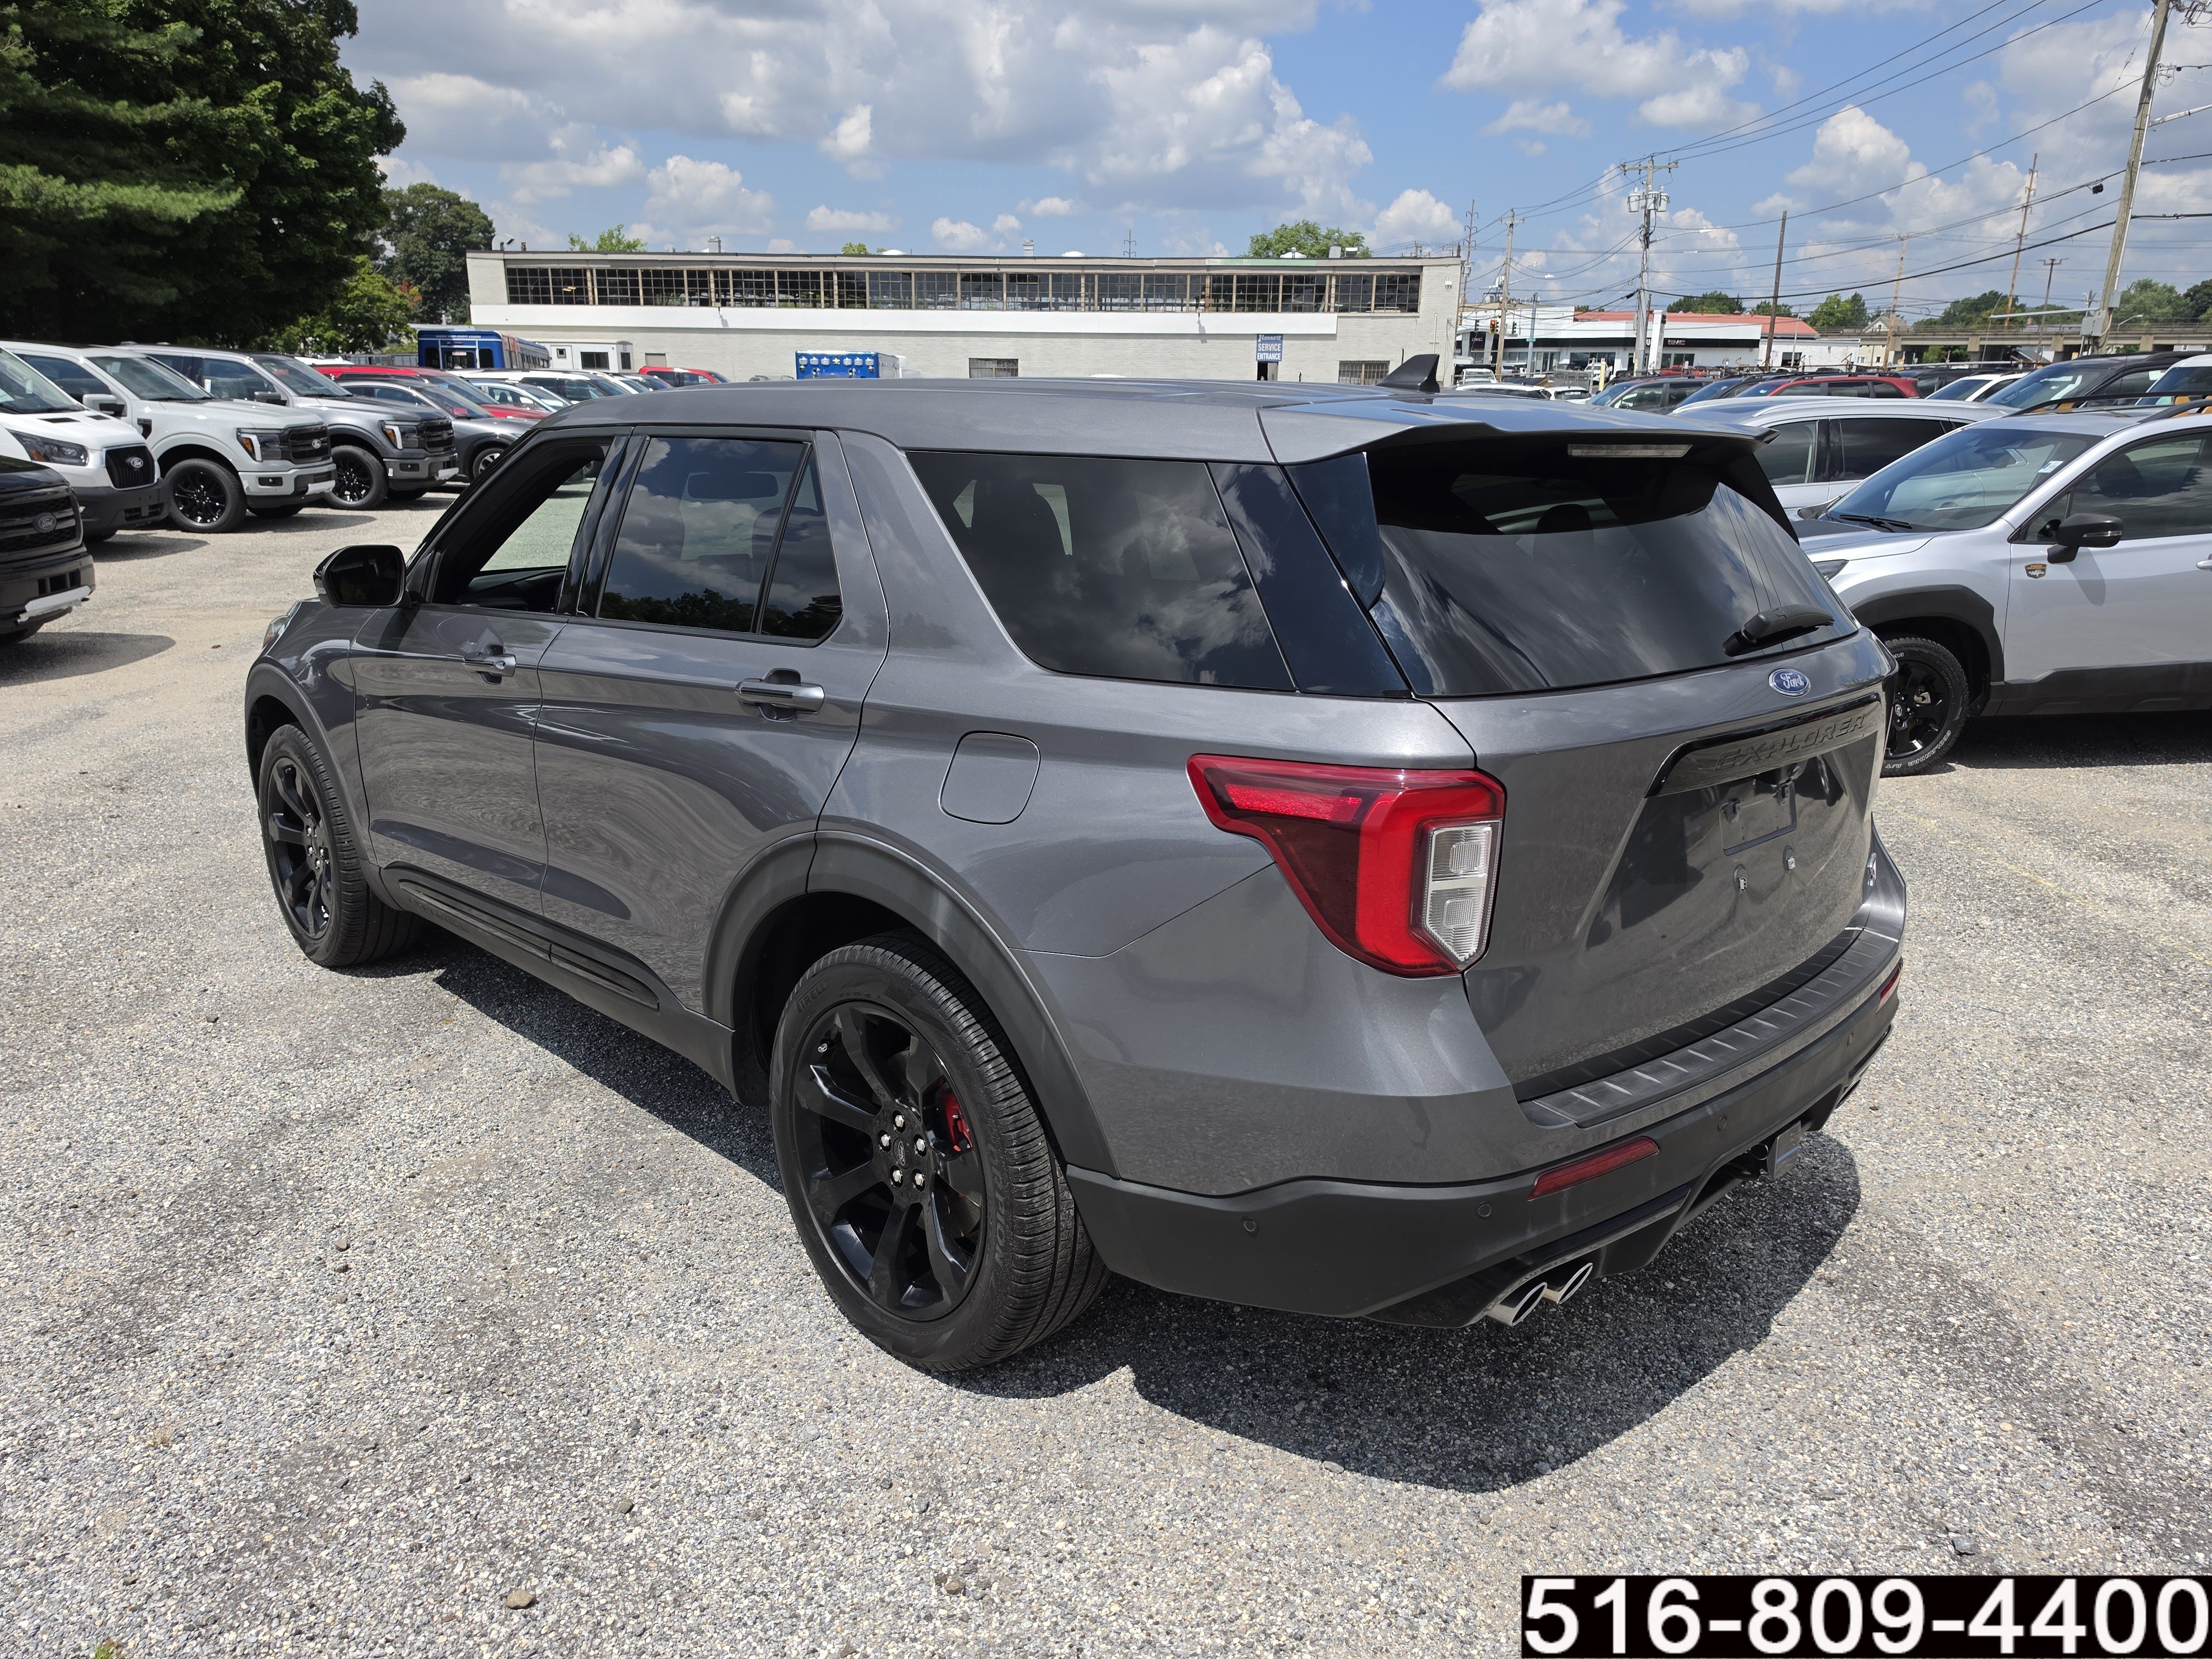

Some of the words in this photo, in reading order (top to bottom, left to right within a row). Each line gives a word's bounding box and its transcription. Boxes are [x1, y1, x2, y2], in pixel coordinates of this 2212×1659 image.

[1258, 343, 1281, 352] SERVICE
[1780, 672, 1804, 689] Ford
[1714, 713, 1865, 770] EXPLORER
